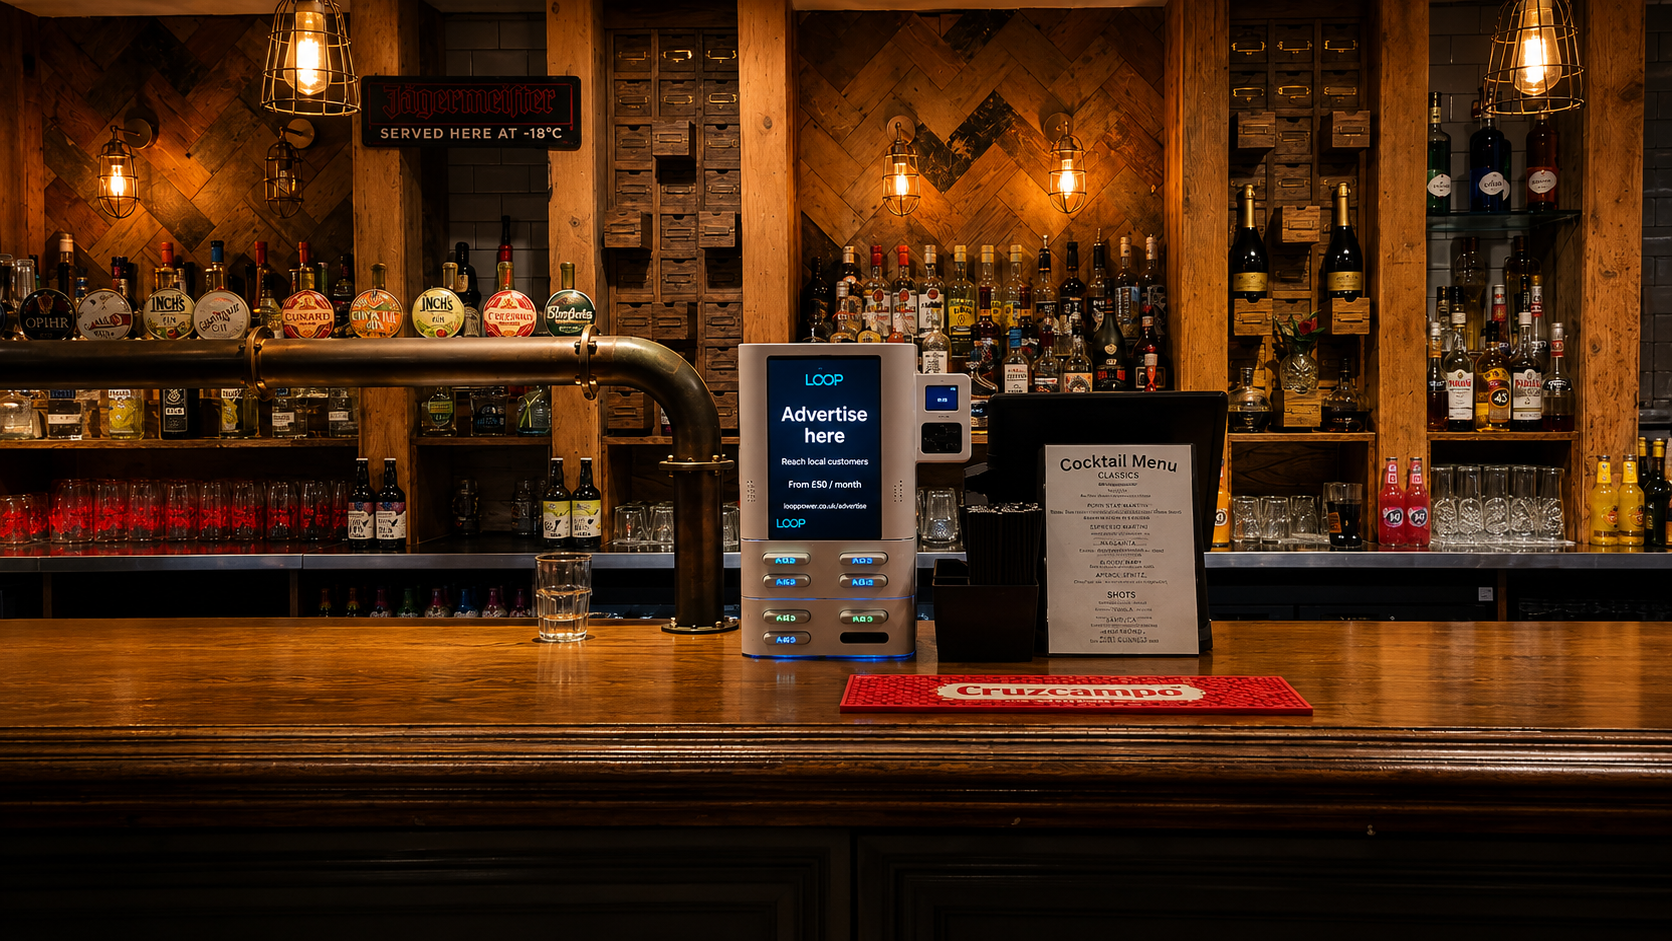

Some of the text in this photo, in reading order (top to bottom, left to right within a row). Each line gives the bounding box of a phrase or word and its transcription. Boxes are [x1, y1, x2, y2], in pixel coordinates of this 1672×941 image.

[380, 127, 563, 139] SERVED HERE AT -18°C
[150, 296, 186, 312] INCH'S
[419, 295, 454, 312] INCH'S
[25, 317, 70, 329] OPIHR
[284, 312, 331, 322] CUNARD
[805, 374, 844, 386] LOOP
[781, 406, 868, 422] Advertise
[804, 427, 845, 444] here
[781, 457, 869, 466] Reach local customers
[1059, 453, 1178, 473] Cocktail Menu
[1097, 471, 1140, 480] CLASSICS
[788, 480, 810, 489] From
[828, 480, 834, 490] /
[835, 480, 862, 489] month
[783, 503, 868, 511] looppower.co.uk/advertise
[776, 518, 806, 528] LOOP
[1107, 591, 1136, 599] SHOTS
[956, 683, 1185, 699] Cruzcampo
